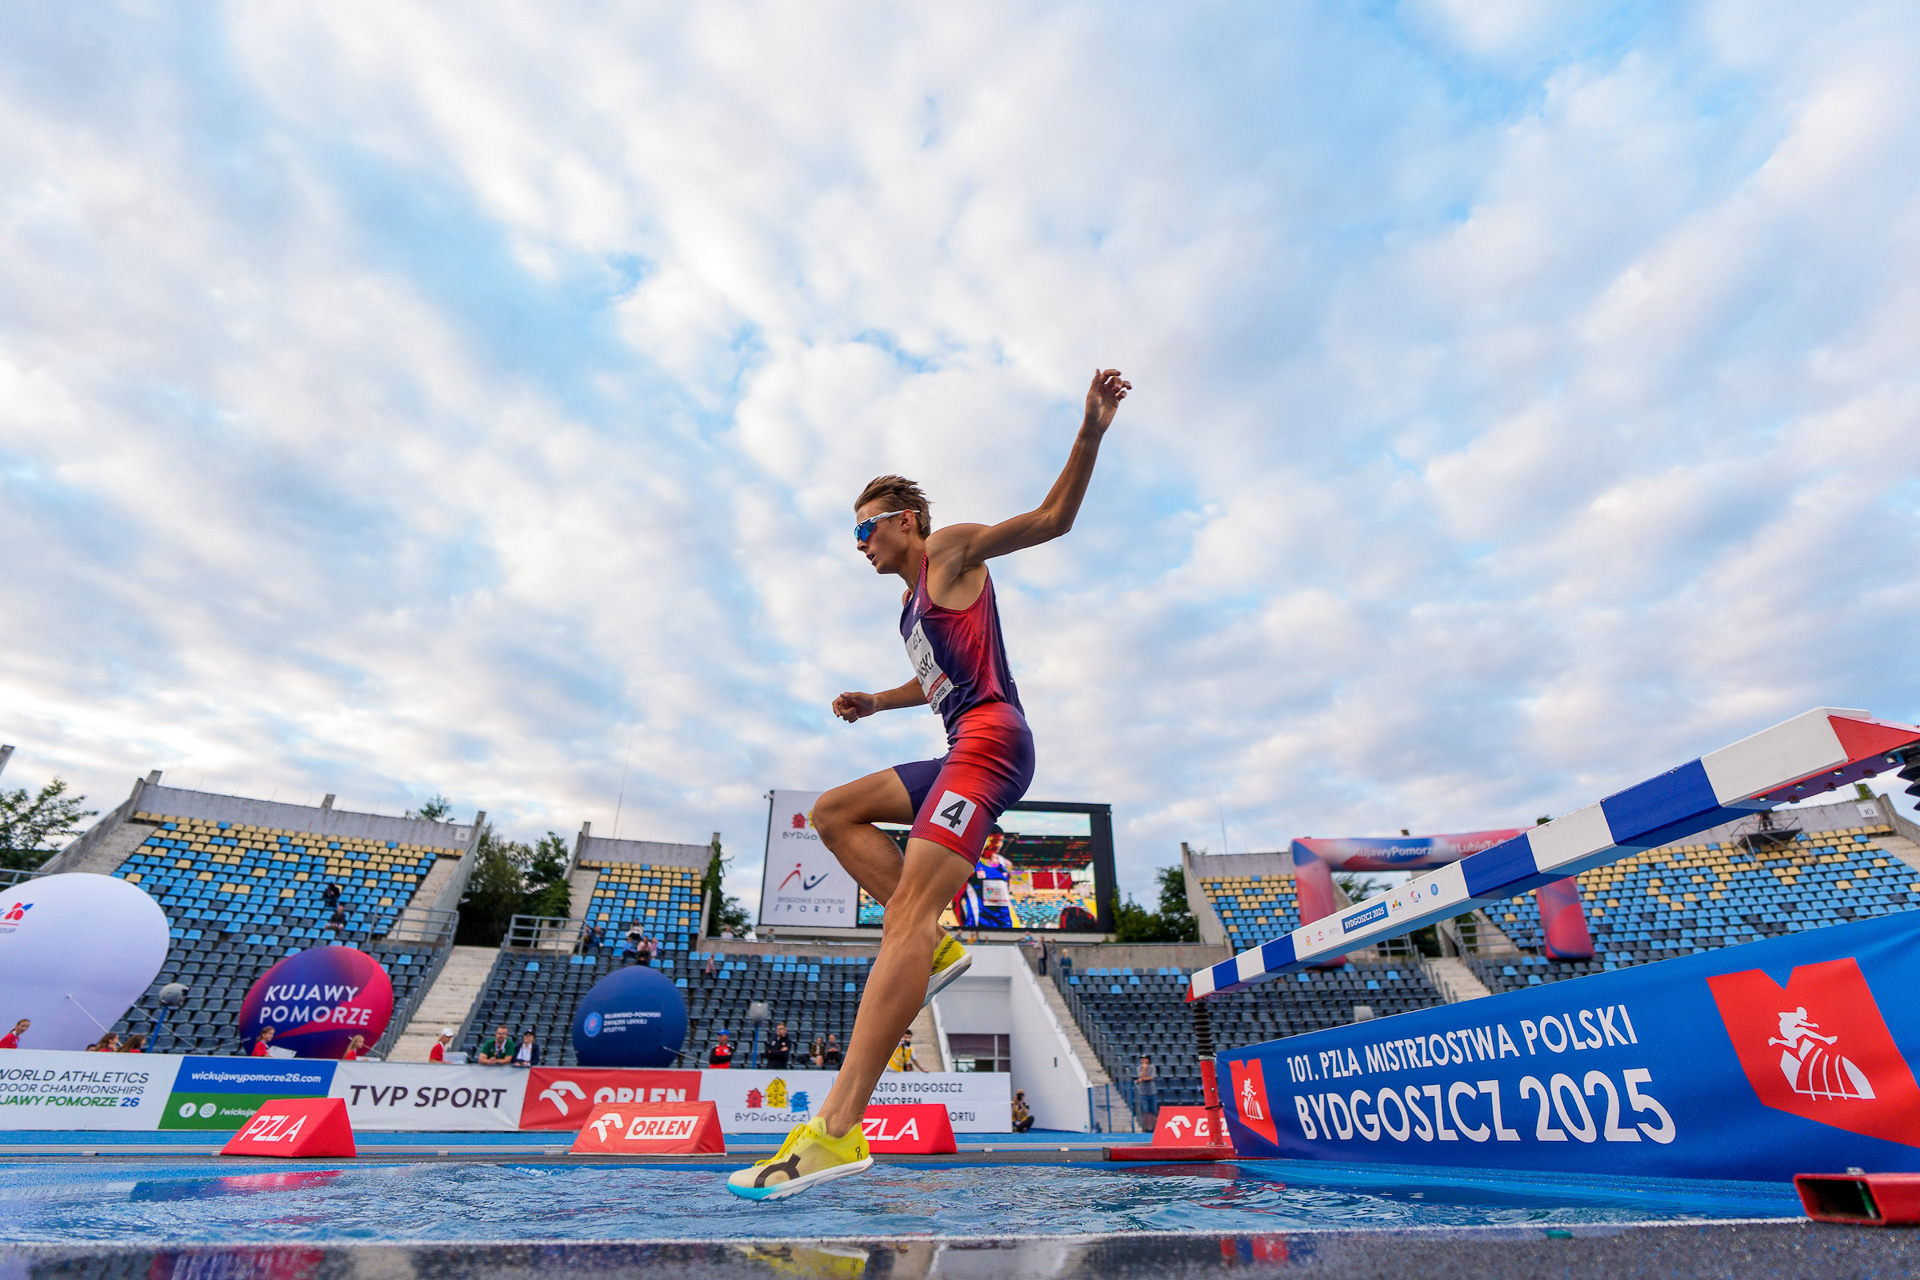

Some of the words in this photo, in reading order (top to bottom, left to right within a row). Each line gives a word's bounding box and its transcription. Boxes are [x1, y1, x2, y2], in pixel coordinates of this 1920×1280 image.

[941, 799, 966, 829] 4
[782, 831, 821, 841] BYDGO
[1345, 911, 1373, 930] BYDGOSZCZ
[1372, 906, 1385, 918] 2025
[264, 984, 358, 1003] KUJAWY
[259, 1005, 373, 1026] POMORZE
[1287, 1054, 1319, 1083] 101.
[1319, 1047, 1363, 1080] PZLA
[1364, 1024, 1520, 1074] MISTRZOSTWA
[1519, 1004, 1638, 1056] POLSKI
[58, 1070, 150, 1084] ATHLETICS
[191, 1071, 322, 1083] wickujawypomorze26.com
[39, 1084, 145, 1095] CHAMPIONSHIPS
[901, 1083, 963, 1093] BYDGOSZCZ
[45, 1095, 119, 1107] POMORZE
[120, 1097, 140, 1107] 26
[350, 1085, 408, 1107] TVP
[414, 1085, 507, 1109] SPORT
[1294, 1079, 1521, 1142] BYDGOSZCZ
[1519, 1068, 1676, 1144] 2025
[734, 1112, 807, 1123] BYDGOSZCZ
[239, 1115, 307, 1142] PZLA
[632, 1120, 692, 1136] ORLEN
